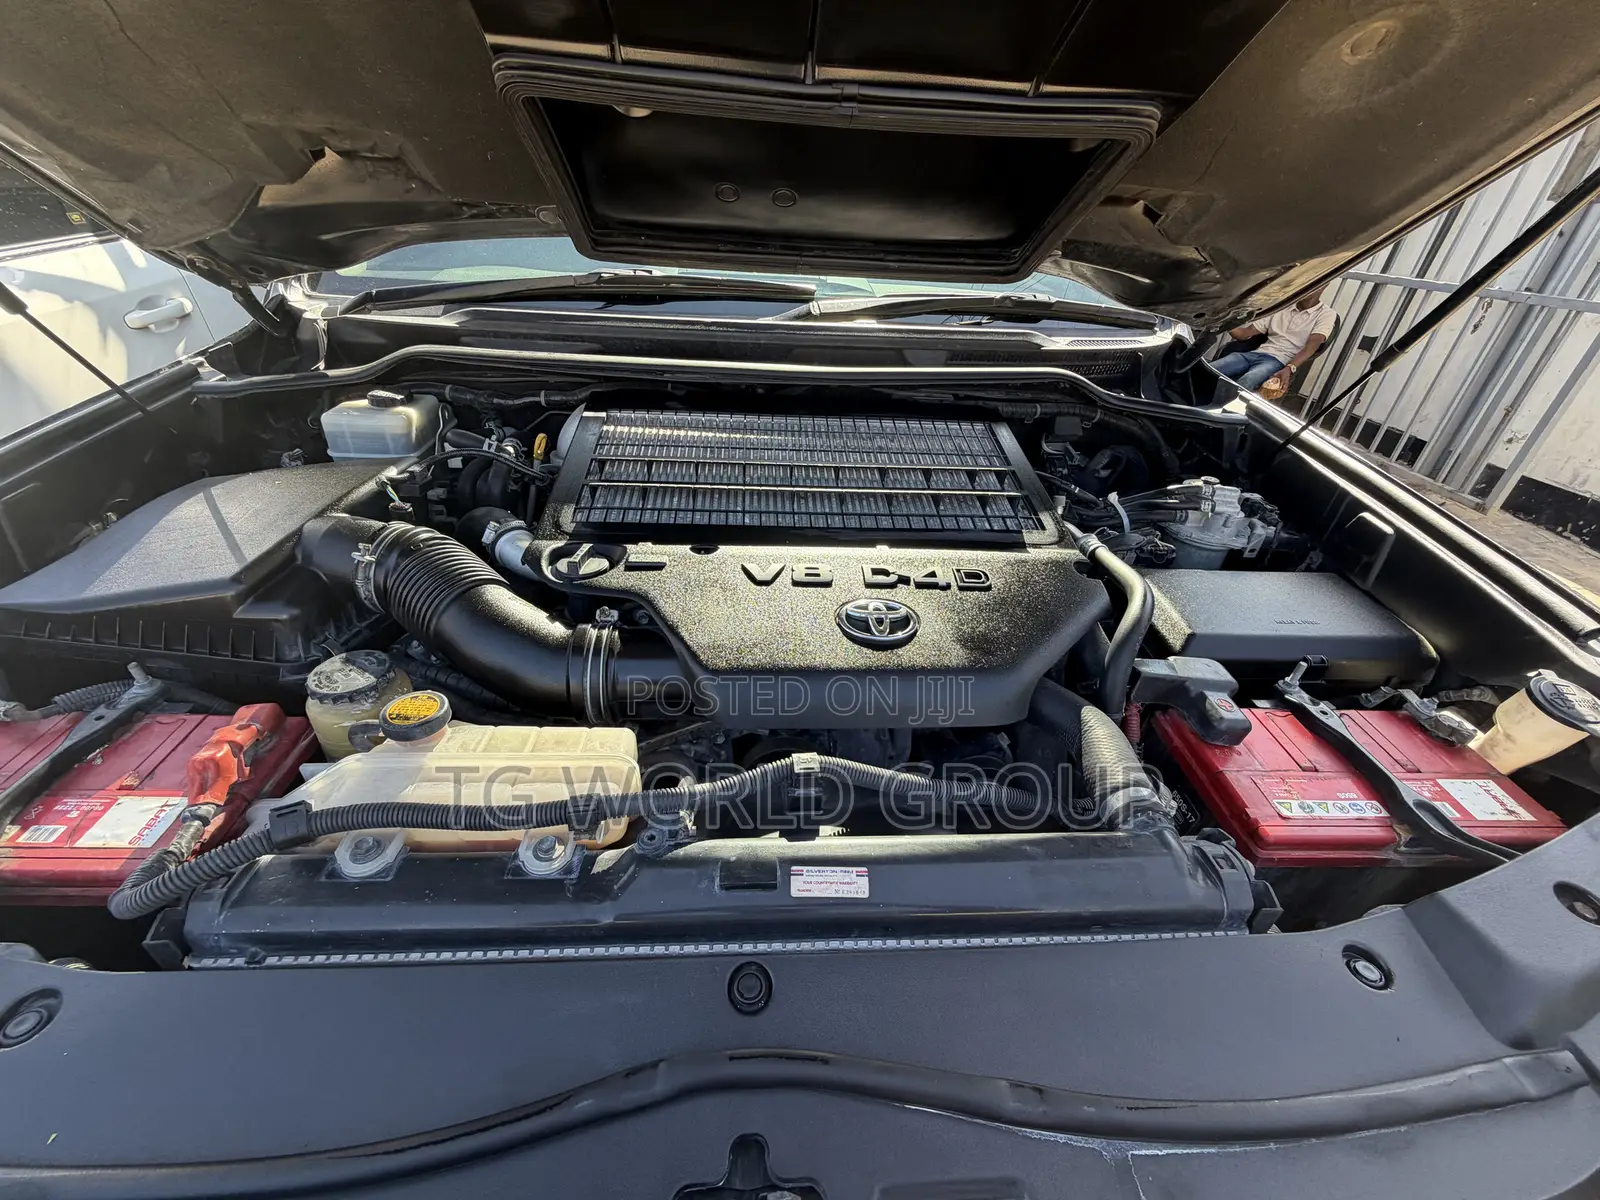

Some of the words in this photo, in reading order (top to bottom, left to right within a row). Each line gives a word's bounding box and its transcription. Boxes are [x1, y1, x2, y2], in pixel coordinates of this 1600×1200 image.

[741, 563, 833, 587] V8
[861, 565, 992, 591] D-4D
[128, 799, 172, 846] SABAT
